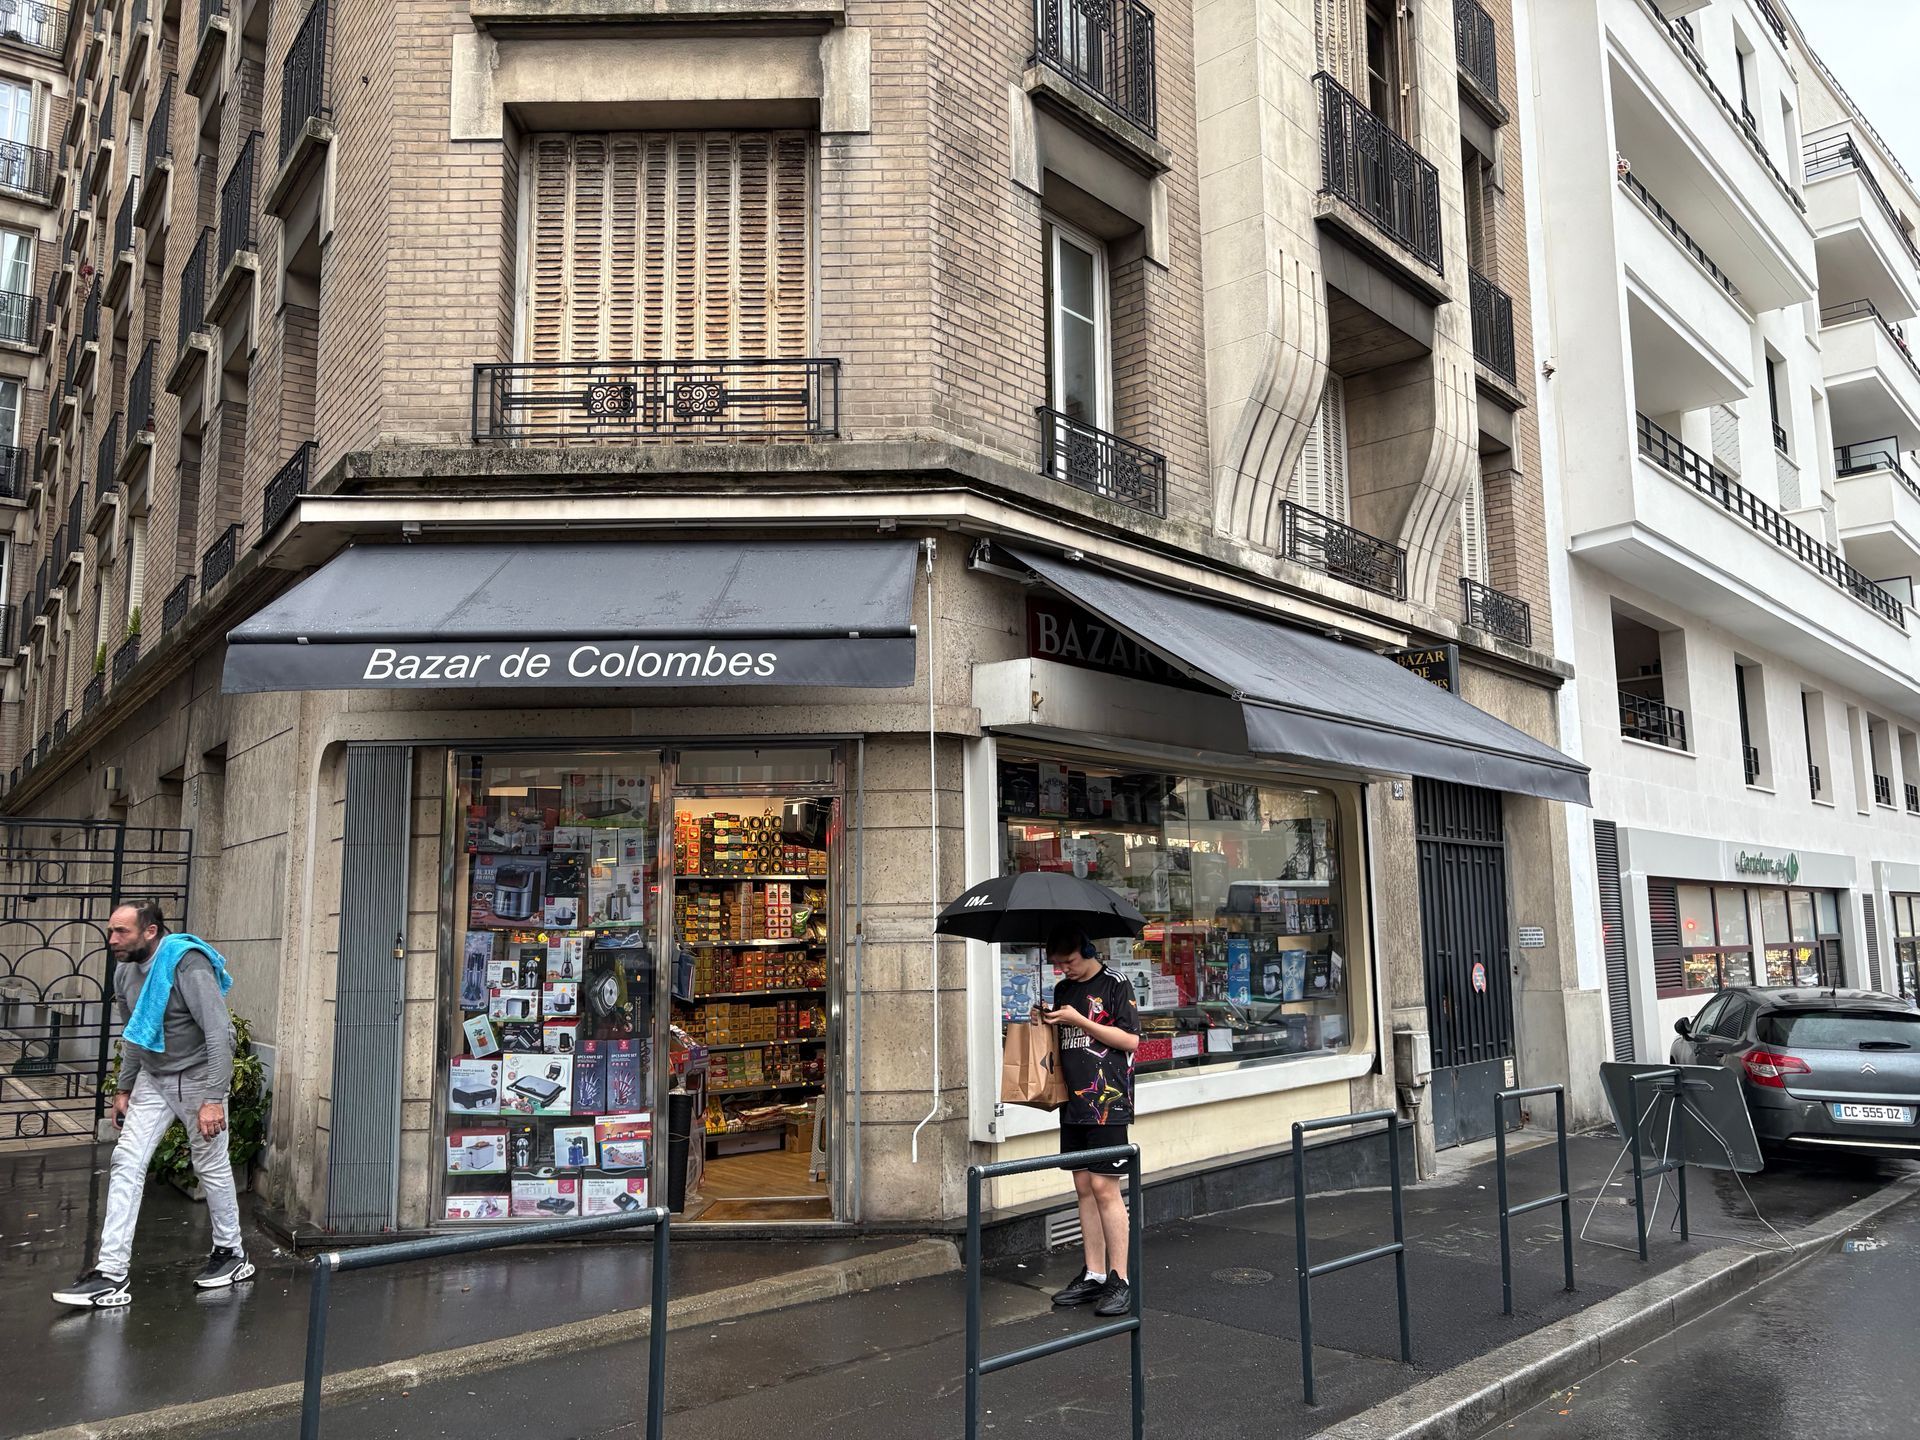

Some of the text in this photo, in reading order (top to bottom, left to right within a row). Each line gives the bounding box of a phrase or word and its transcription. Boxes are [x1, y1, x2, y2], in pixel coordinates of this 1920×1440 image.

[362, 644, 778, 681] Bazar de Colombes
[1397, 650, 1445, 666] BAZAR
[1410, 667, 1430, 678] DE
